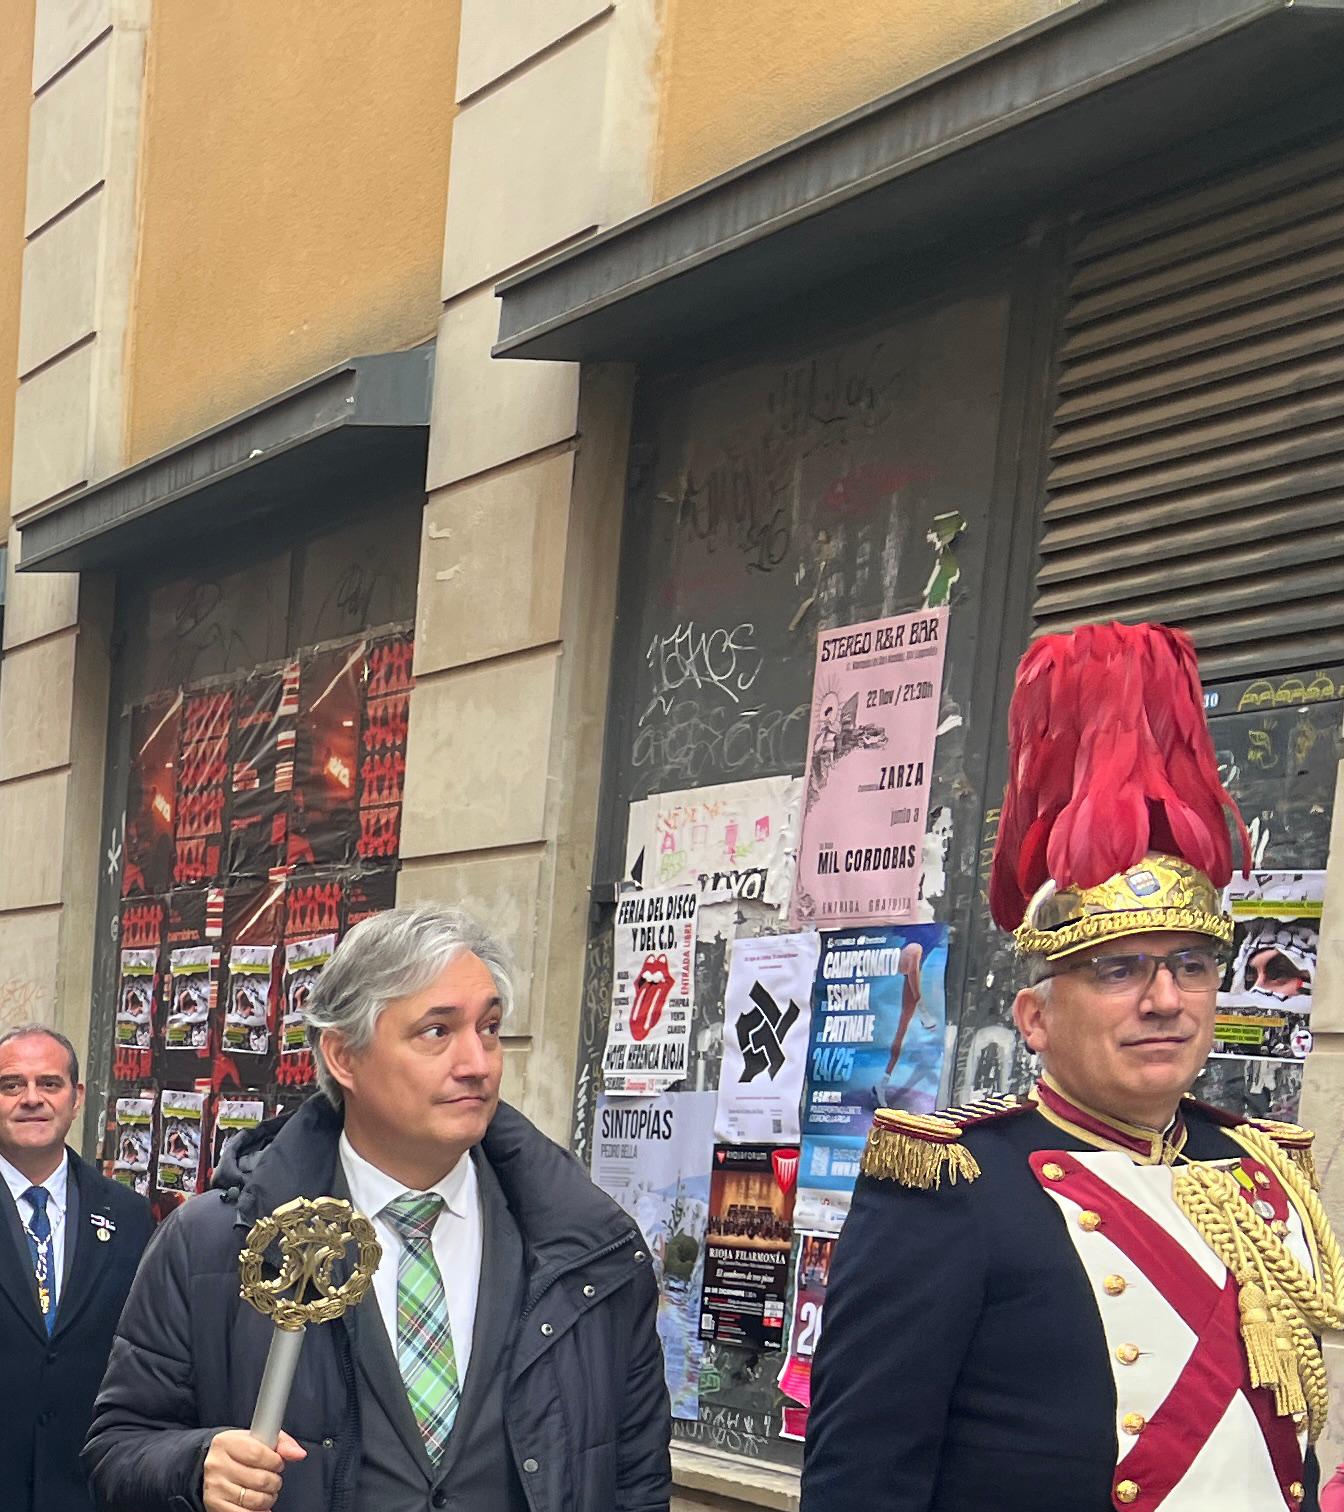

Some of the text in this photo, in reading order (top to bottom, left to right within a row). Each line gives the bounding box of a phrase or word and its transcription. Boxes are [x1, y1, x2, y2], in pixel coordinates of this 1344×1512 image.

[821, 631, 872, 662] STEREO
[875, 624, 905, 652] R&R
[908, 618, 939, 645] BAR
[866, 689, 878, 708] 22
[879, 762, 924, 790] ZARZA
[817, 845, 916, 875] MIL CORDOBAS
[618, 893, 696, 925] FERIA DEL DISCO
[823, 897, 912, 915] ENTRADA GRATUITA
[632, 925, 677, 952] Y DEL C.D.
[681, 951, 691, 995] ENTRADA
[823, 947, 901, 979] CAMPEONATO
[827, 978, 870, 1011] ESPAÑA
[822, 1014, 875, 1042] PATINAJE
[661, 1043, 685, 1070] RIOJA
[812, 1048, 856, 1082] 24/25
[602, 1103, 673, 1140] SINTOPÍAS
[600, 1143, 638, 1159] PEDRO BELLA
[709, 1248, 733, 1261] RIOJA
[734, 1250, 786, 1265] FILARMONÍA
